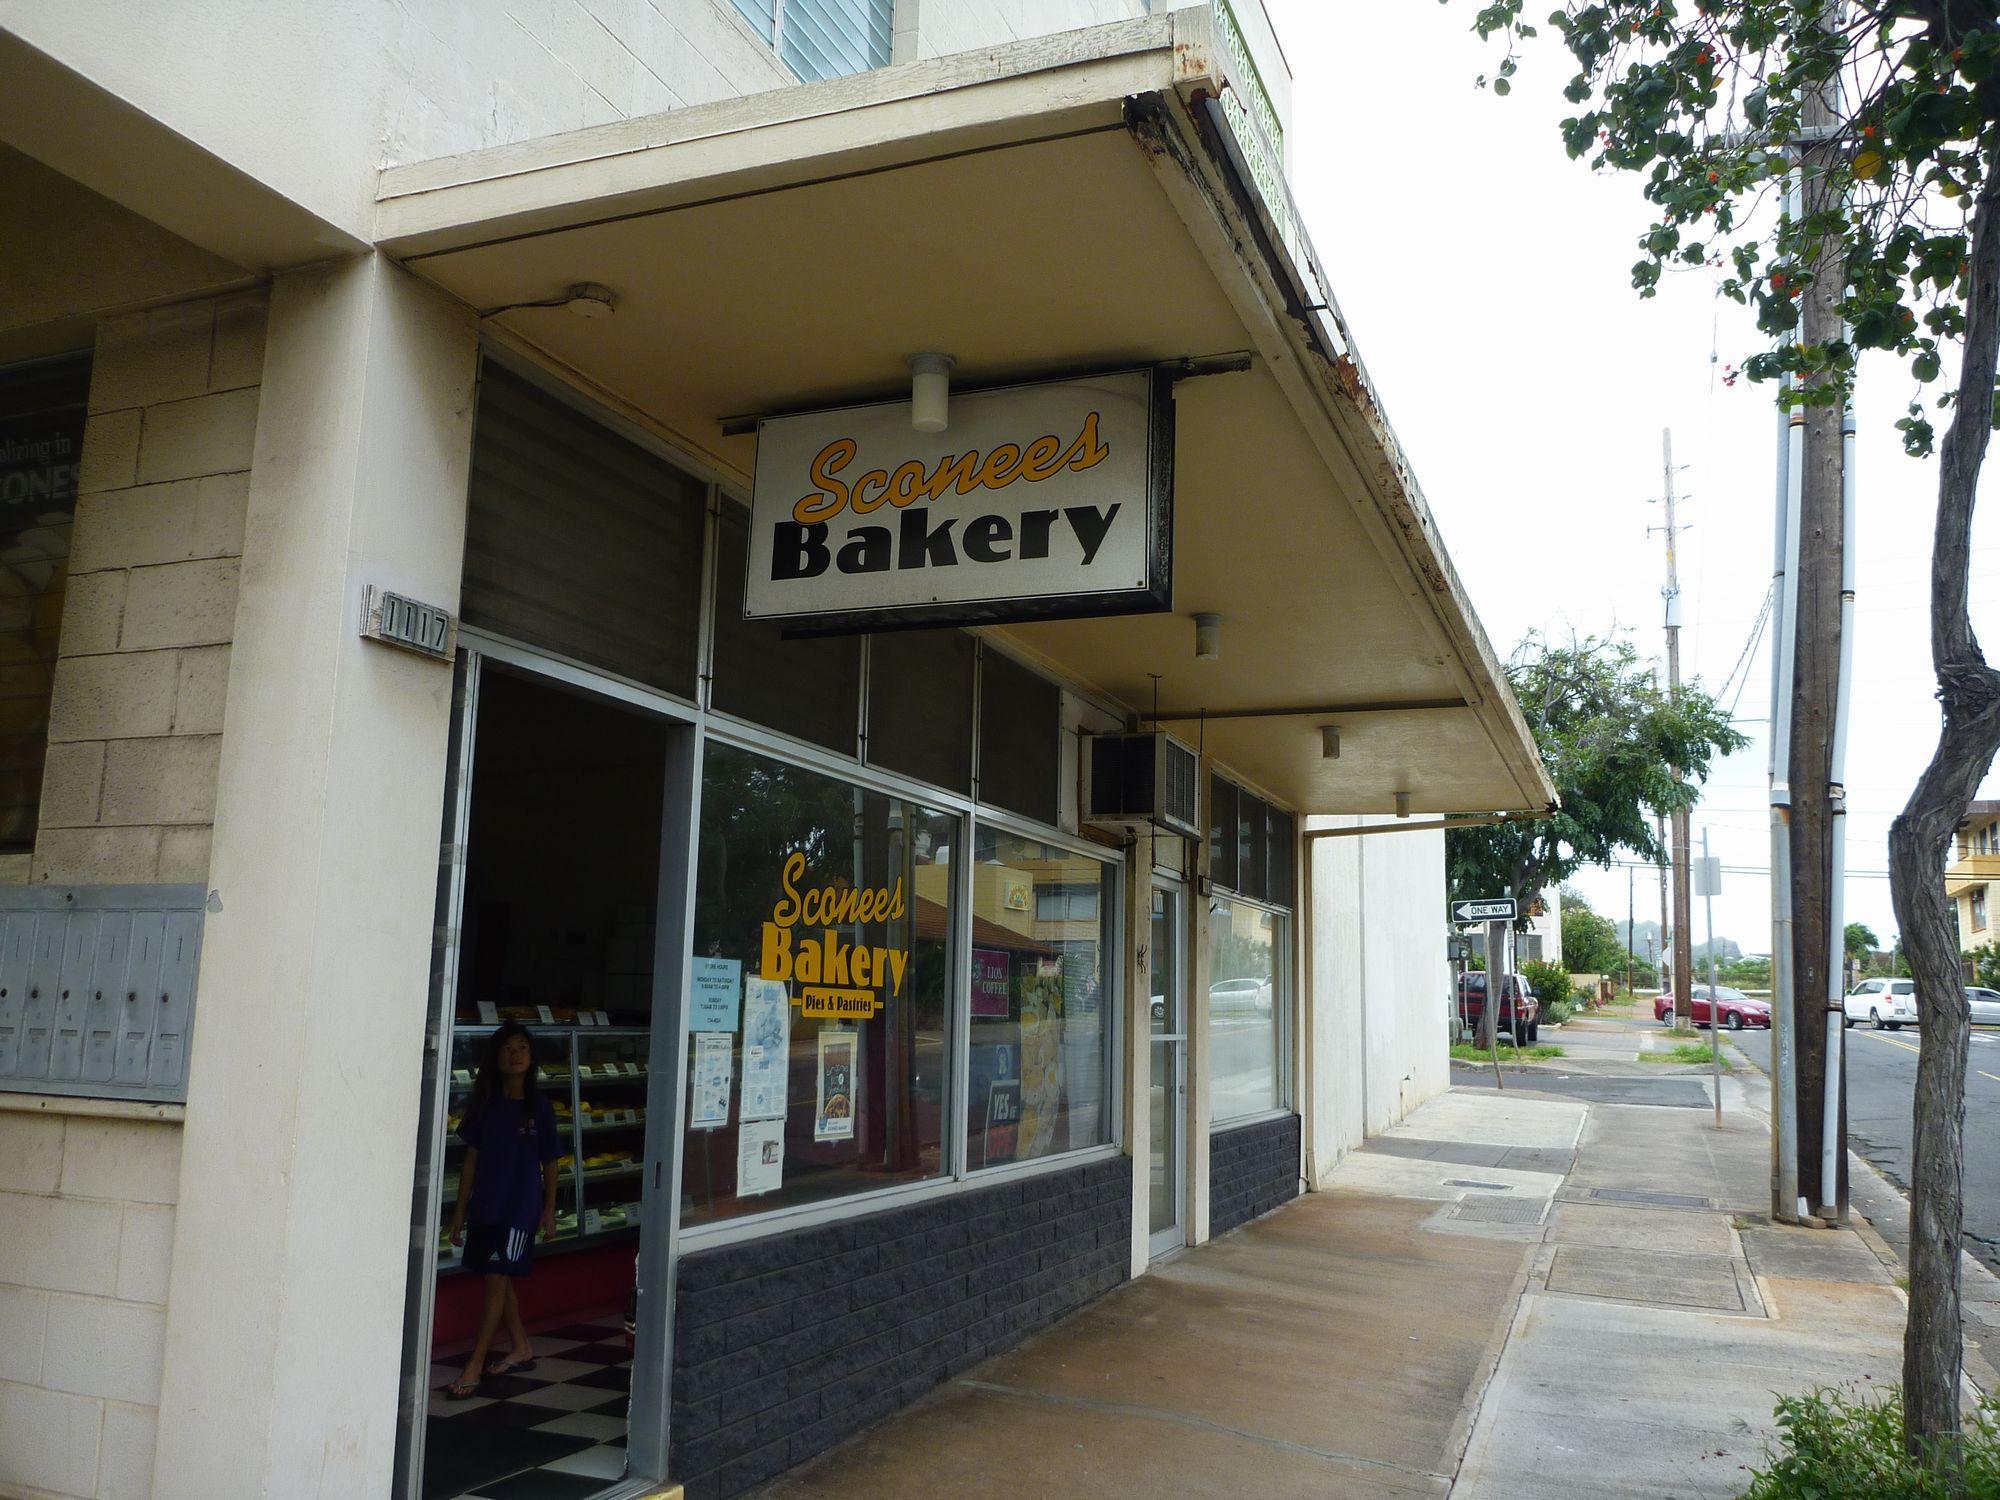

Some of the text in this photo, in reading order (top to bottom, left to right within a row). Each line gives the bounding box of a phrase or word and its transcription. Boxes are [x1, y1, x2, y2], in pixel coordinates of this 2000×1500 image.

[55, 431, 71, 455] in
[0, 461, 80, 504] ONES
[792, 411, 1110, 525] Sconees
[770, 502, 1121, 581] Bakery
[388, 600, 446, 647] 1117
[773, 852, 905, 928] Sconees
[1471, 905, 1509, 915] ONE WAY
[760, 921, 909, 997] Bakery
[987, 966, 1003, 980] LION
[805, 994, 872, 1012] Pies & Pastries
[982, 981, 1008, 995] COFFEE
[993, 1093, 1010, 1120] YES
